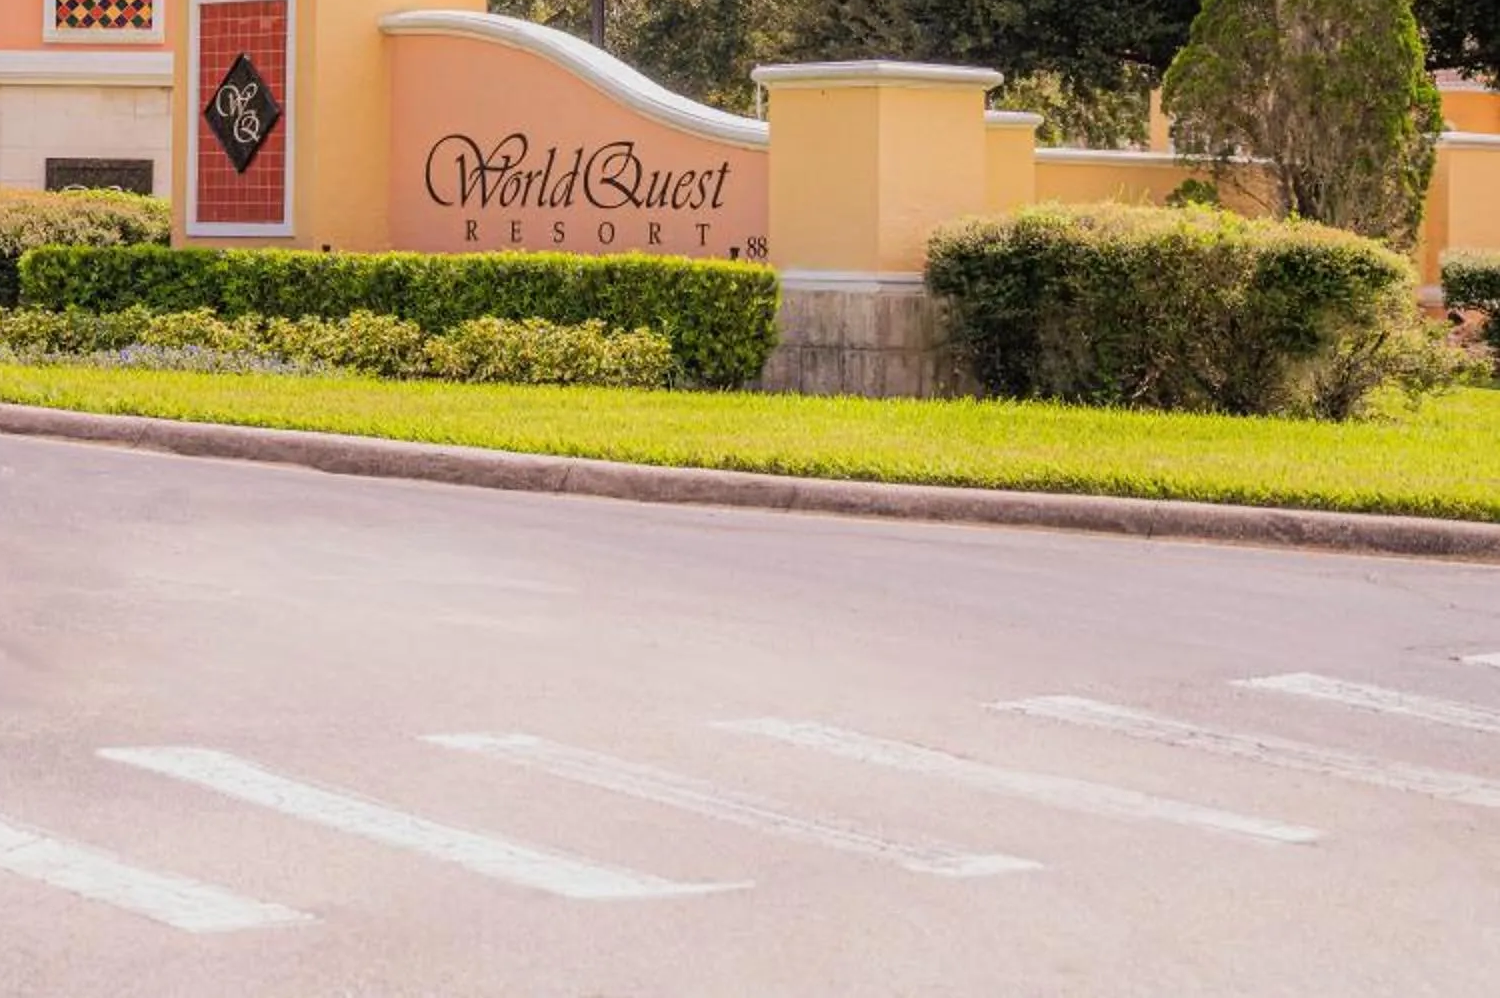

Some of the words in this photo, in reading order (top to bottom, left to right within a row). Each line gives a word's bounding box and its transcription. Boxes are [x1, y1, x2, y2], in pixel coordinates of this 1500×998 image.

[425, 132, 731, 209] WorldQuest
[464, 219, 711, 246] RESORT
[745, 235, 769, 260] 88
